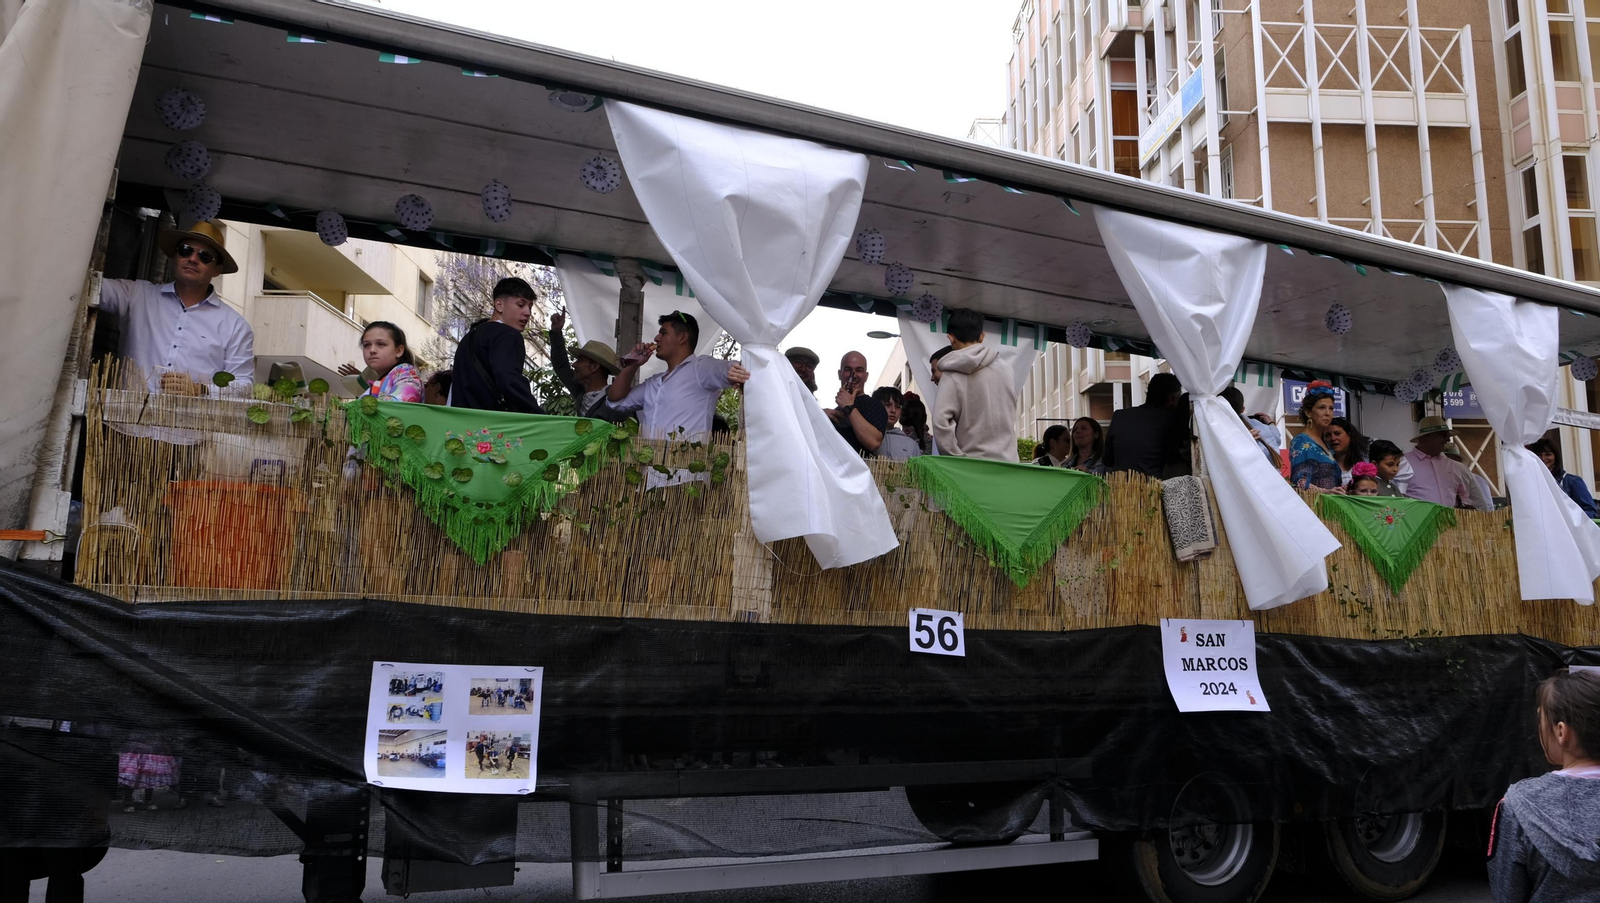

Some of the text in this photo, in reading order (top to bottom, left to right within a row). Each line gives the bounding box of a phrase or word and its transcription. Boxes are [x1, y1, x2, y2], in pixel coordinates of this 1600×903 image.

[1449, 398, 1464, 406] 599
[915, 613, 959, 652] 56
[1195, 633, 1226, 647] SAN
[1181, 657, 1248, 671] MARCOS
[1200, 682, 1237, 695] 2024
